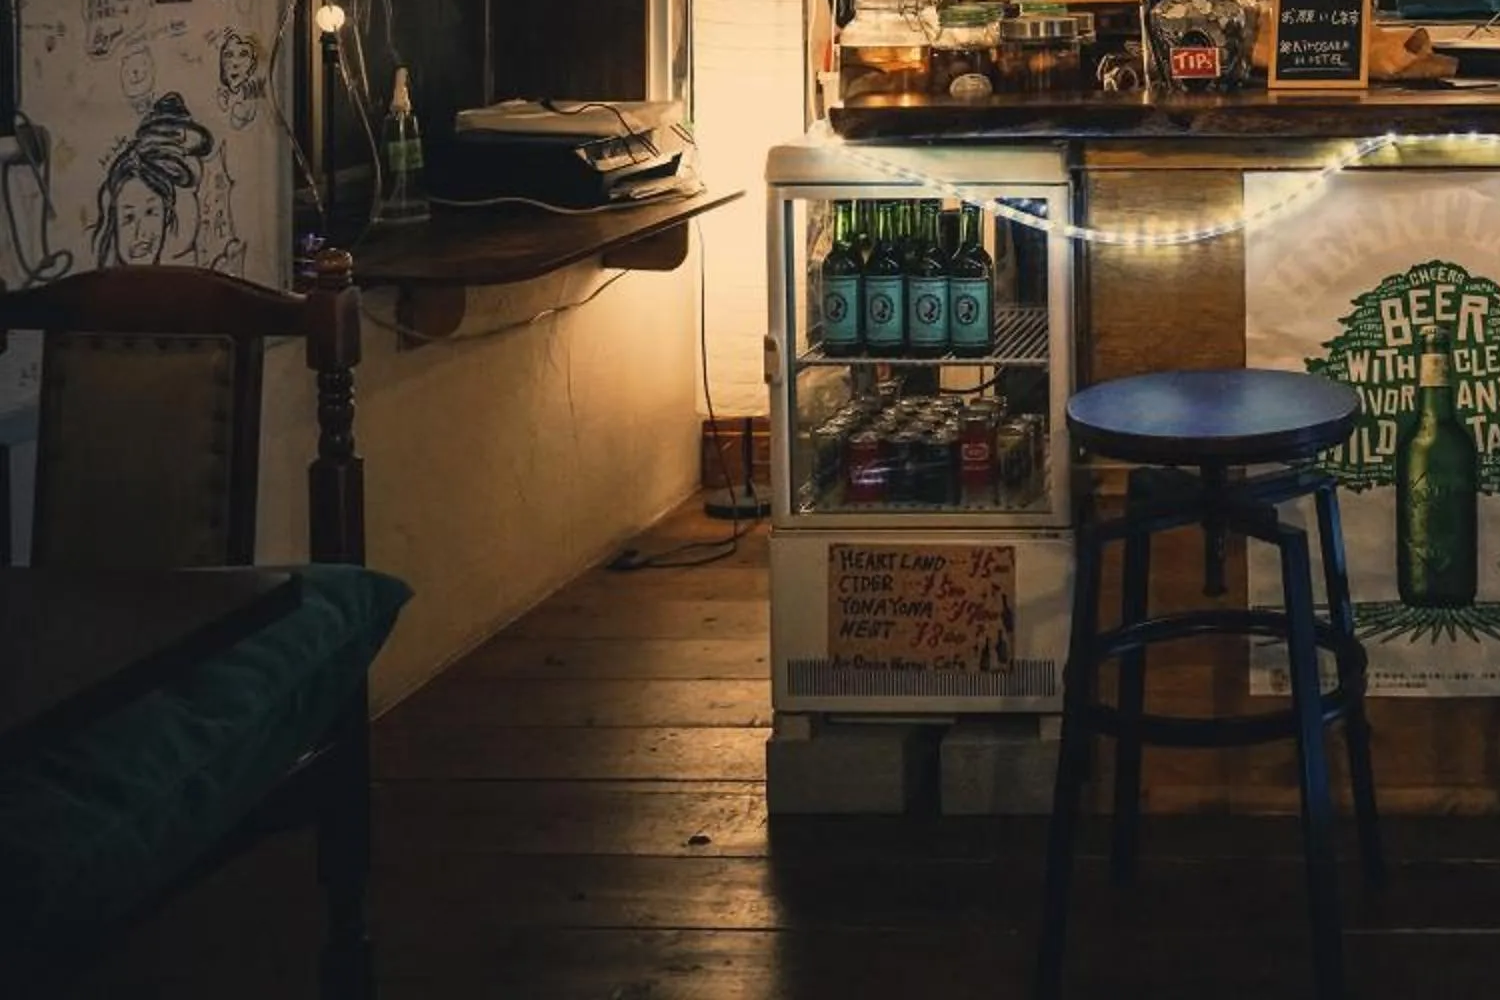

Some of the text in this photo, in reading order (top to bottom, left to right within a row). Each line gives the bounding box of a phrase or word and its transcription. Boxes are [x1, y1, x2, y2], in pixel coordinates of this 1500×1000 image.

[1408, 266, 1465, 287] CHEERS
[1380, 284, 1489, 347] BEER
[1347, 348, 1416, 383] WITH
[838, 574, 894, 594] CIDER
